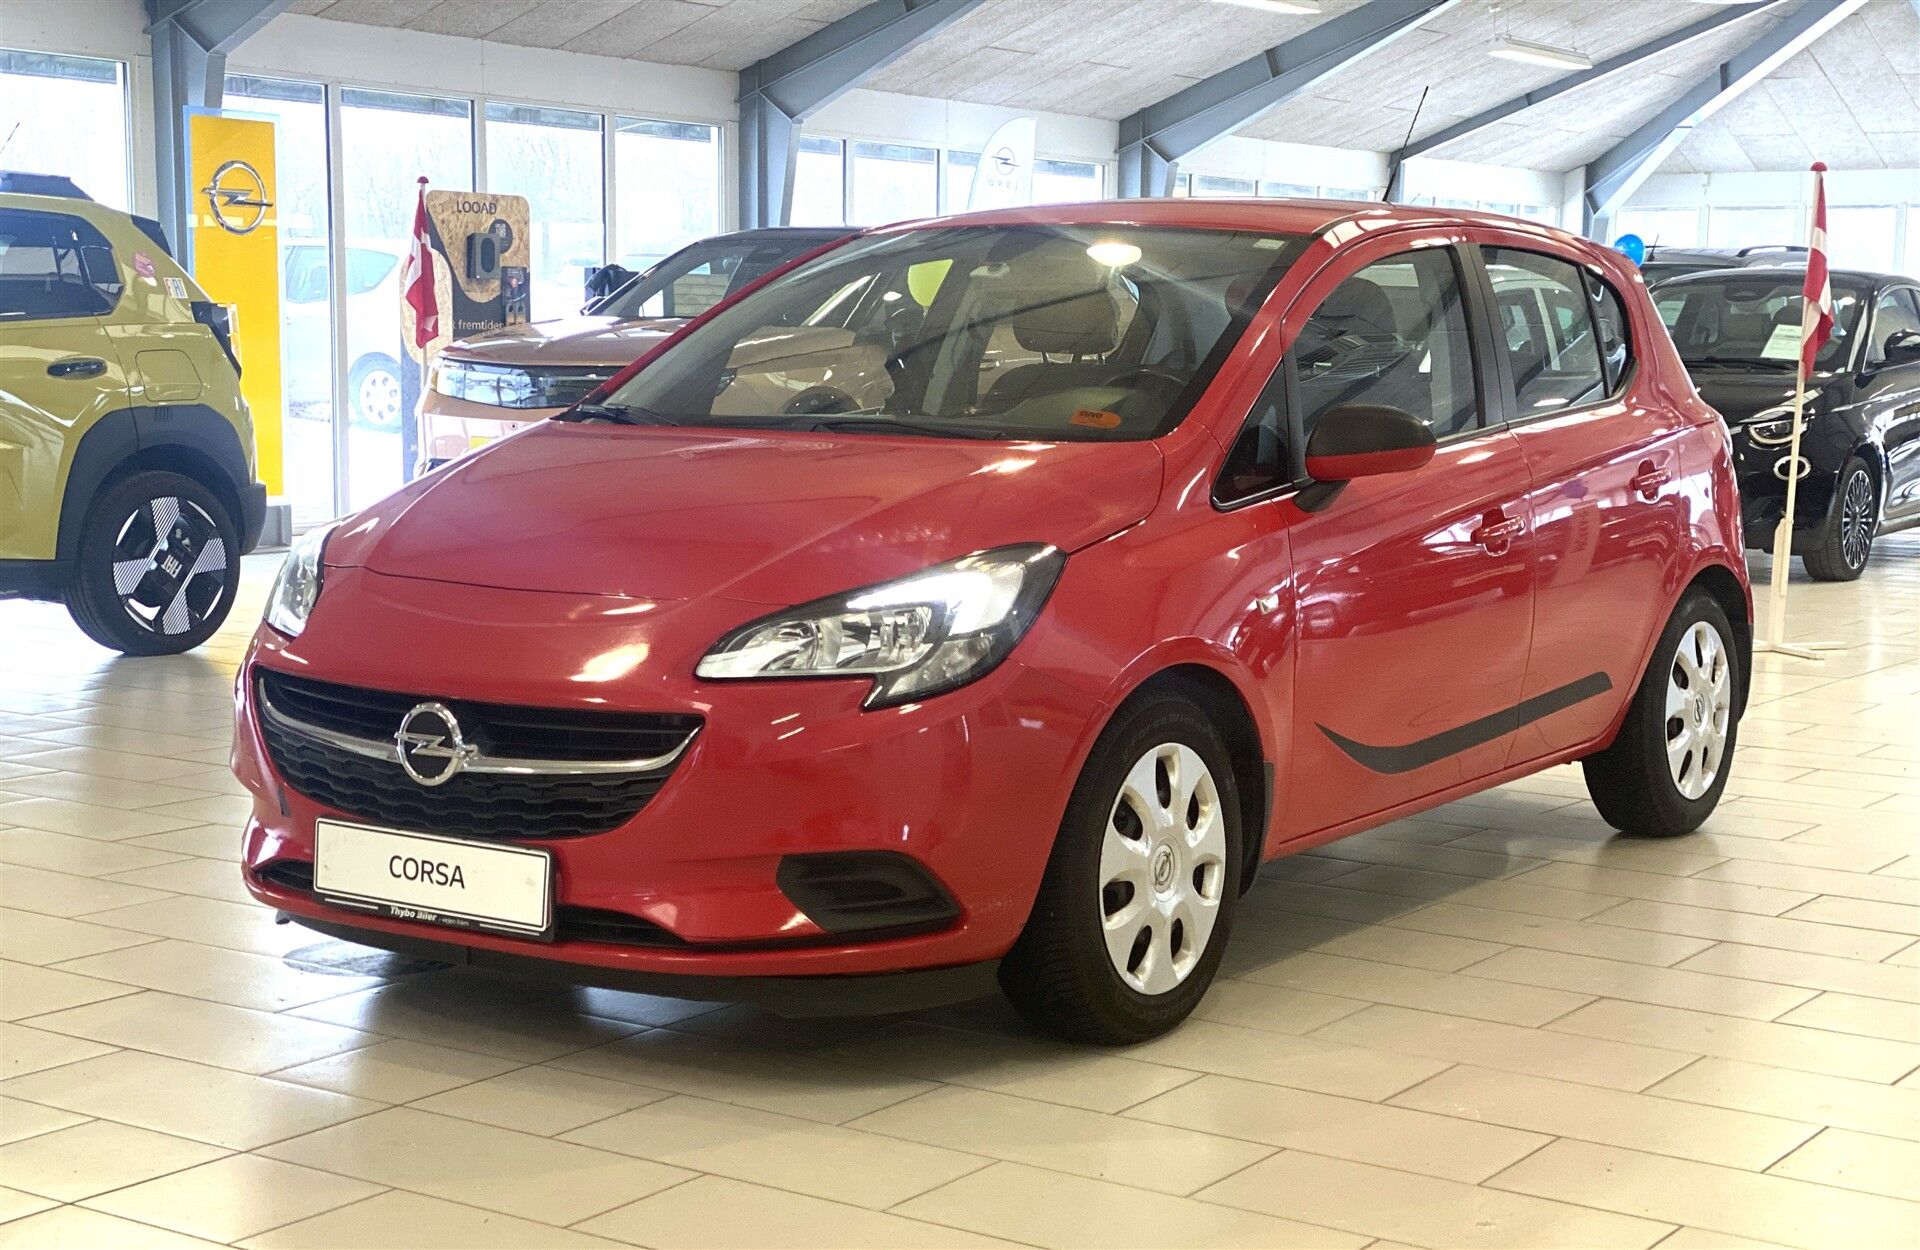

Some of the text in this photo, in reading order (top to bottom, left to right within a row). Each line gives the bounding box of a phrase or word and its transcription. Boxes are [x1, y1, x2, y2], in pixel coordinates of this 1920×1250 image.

[457, 201, 497, 214] LOOAD
[160, 554, 183, 579] FIAT
[388, 854, 465, 890] CORSA
[390, 906, 415, 918] Thybo
[416, 911, 437, 921] Biler
